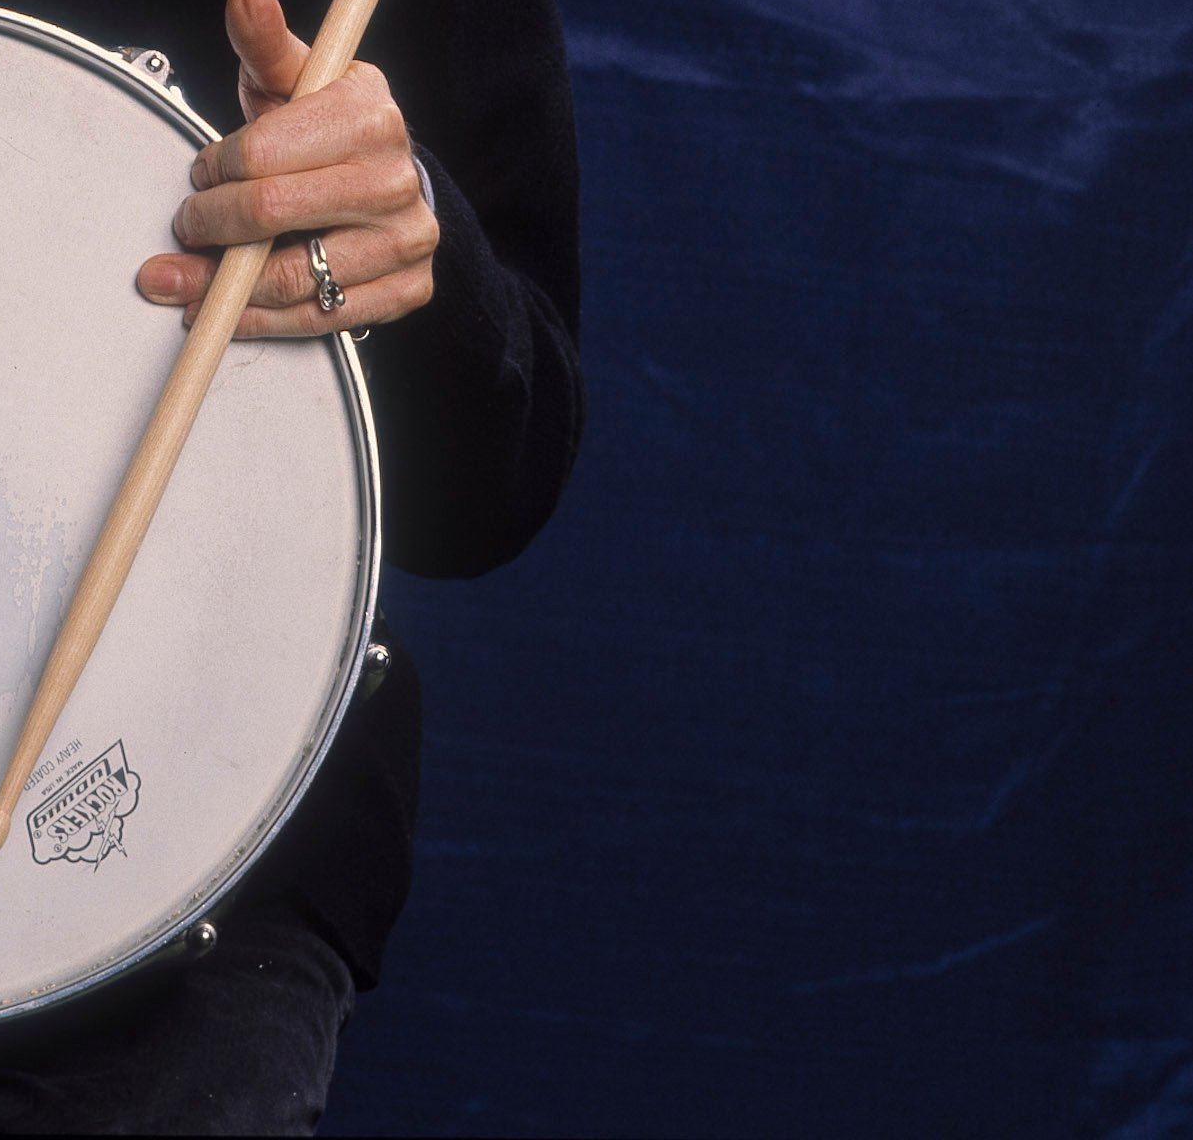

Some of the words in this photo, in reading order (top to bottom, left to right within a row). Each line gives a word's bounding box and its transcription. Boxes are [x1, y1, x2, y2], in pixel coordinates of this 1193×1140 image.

[54, 738, 83, 765] HEAVY
[65, 760, 84, 775] MADE
[55, 775, 64, 784] IN
[41, 782, 54, 796] USA
[47, 773, 128, 845] ROCKERS
